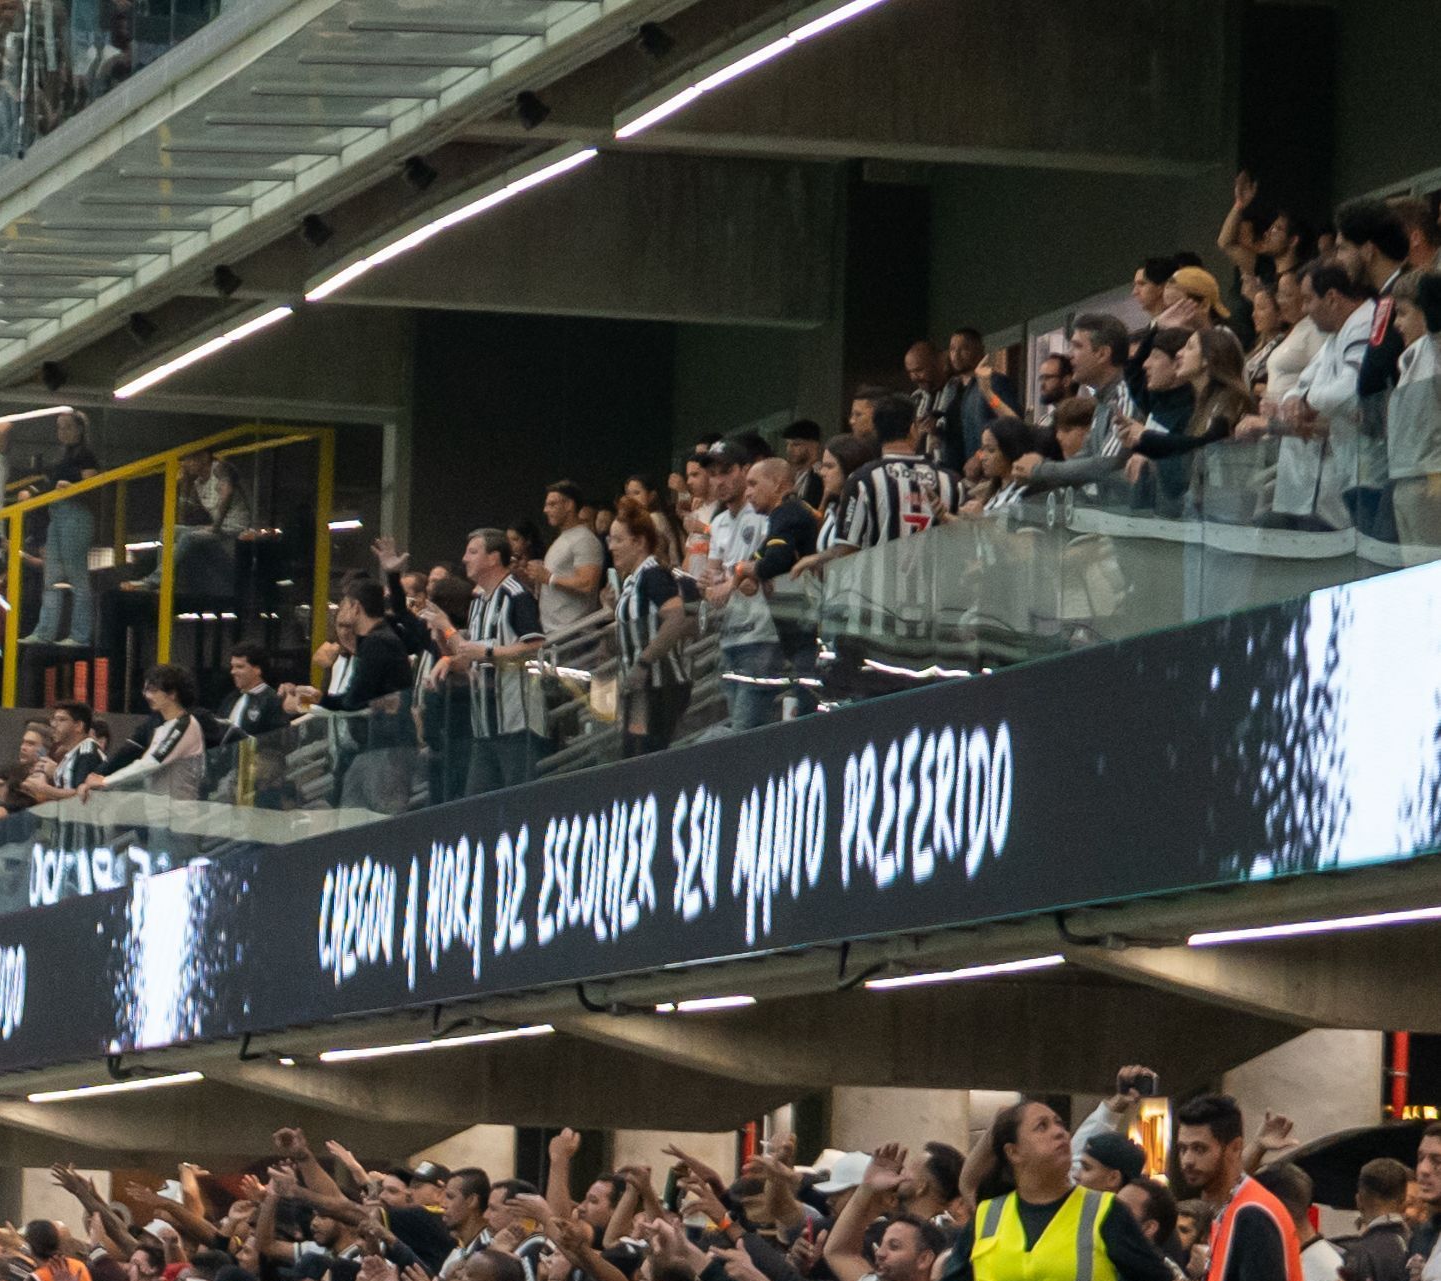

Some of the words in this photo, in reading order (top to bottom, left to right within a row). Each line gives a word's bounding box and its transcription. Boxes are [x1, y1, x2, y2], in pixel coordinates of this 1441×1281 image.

[318, 855, 397, 988] CHEGOU
[402, 856, 420, 989] A
[425, 834, 485, 981] HORA
[493, 823, 529, 955] DE
[537, 792, 657, 945] ESCOLHER
[671, 784, 721, 920] SEU
[731, 757, 826, 944] MANTO
[840, 721, 1012, 888] PREFERIDO
